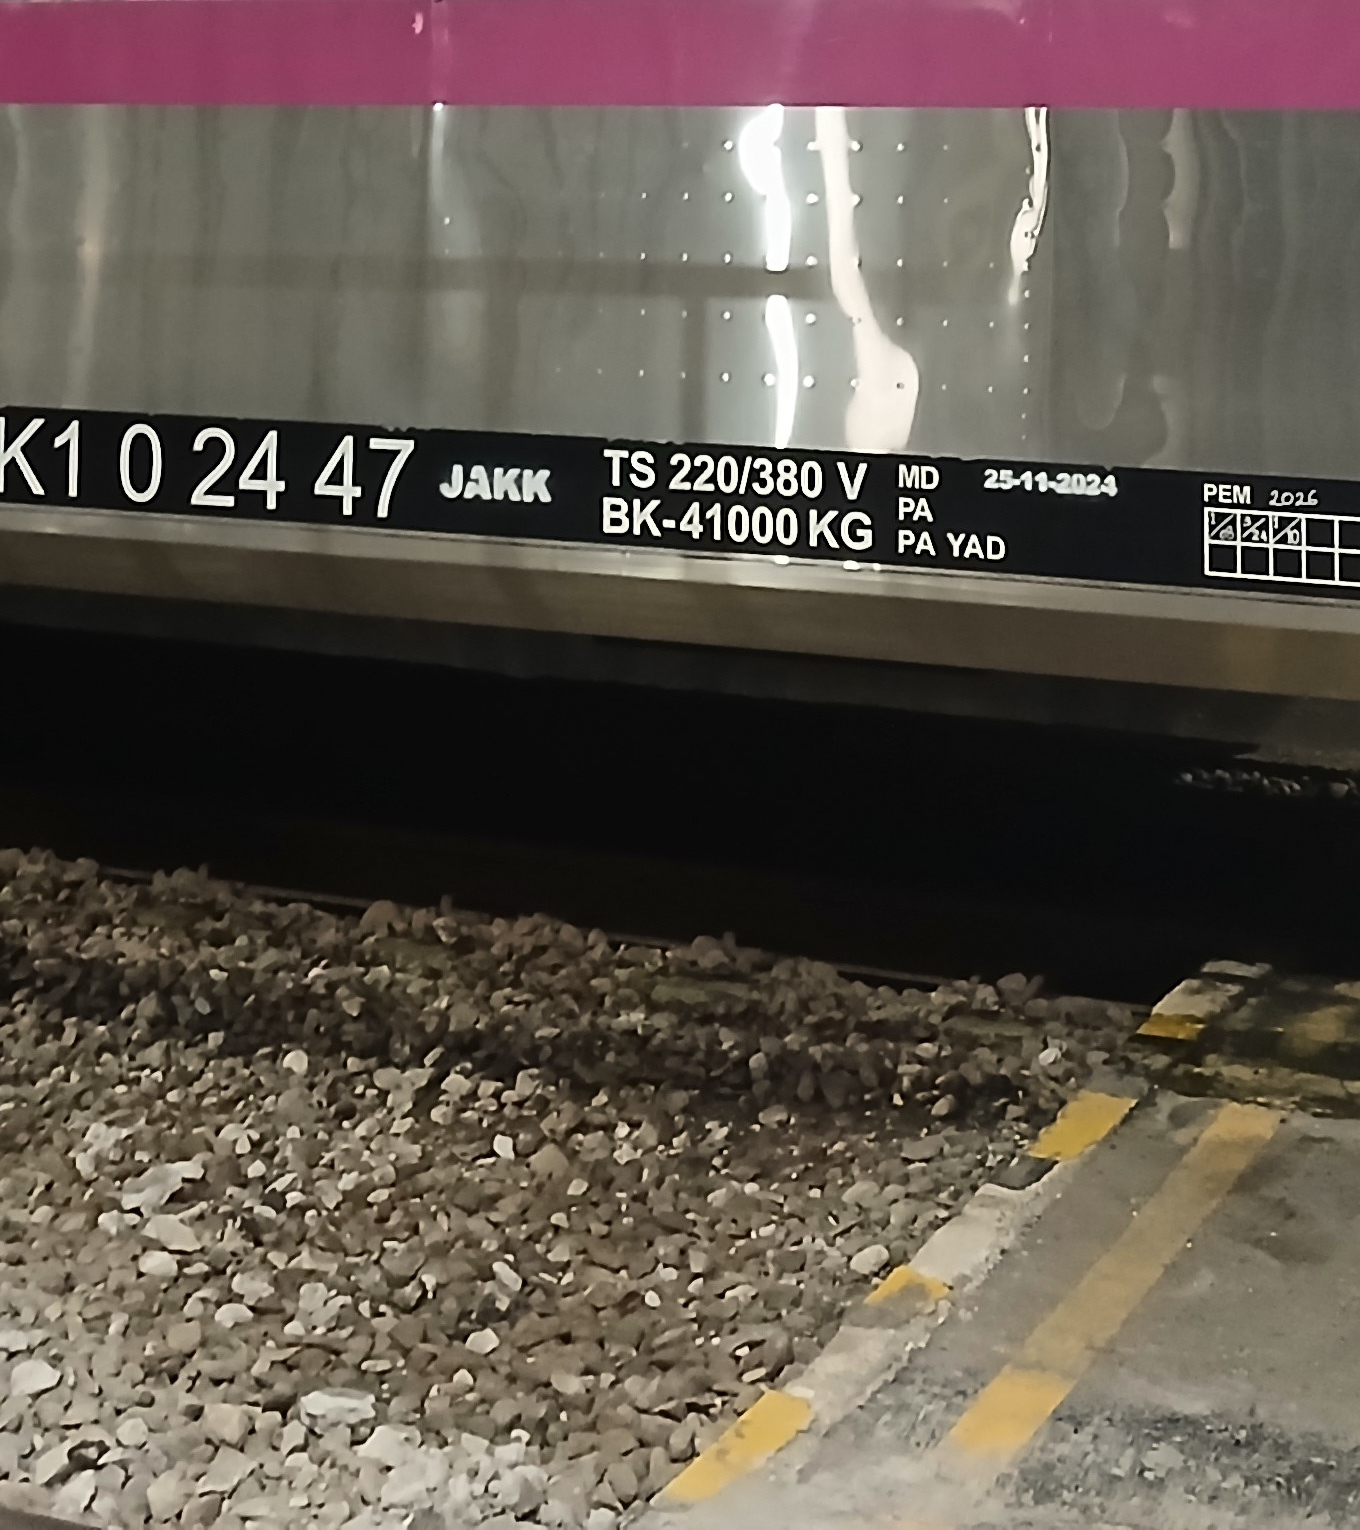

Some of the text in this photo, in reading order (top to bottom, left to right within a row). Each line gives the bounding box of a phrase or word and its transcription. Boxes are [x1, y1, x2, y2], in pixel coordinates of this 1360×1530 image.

[119, 423, 162, 503] 0
[190, 427, 286, 510] 24
[314, 434, 416, 518] 47
[439, 464, 552, 504] JAKK
[603, 449, 868, 501] TS 220/380 V
[898, 464, 1119, 497] MD 25-11-2024
[898, 497, 934, 522] PA
[1203, 483, 1319, 506] PEM 2026
[602, 497, 873, 551] BK-41000 KG
[898, 529, 1007, 561] PA YAD
